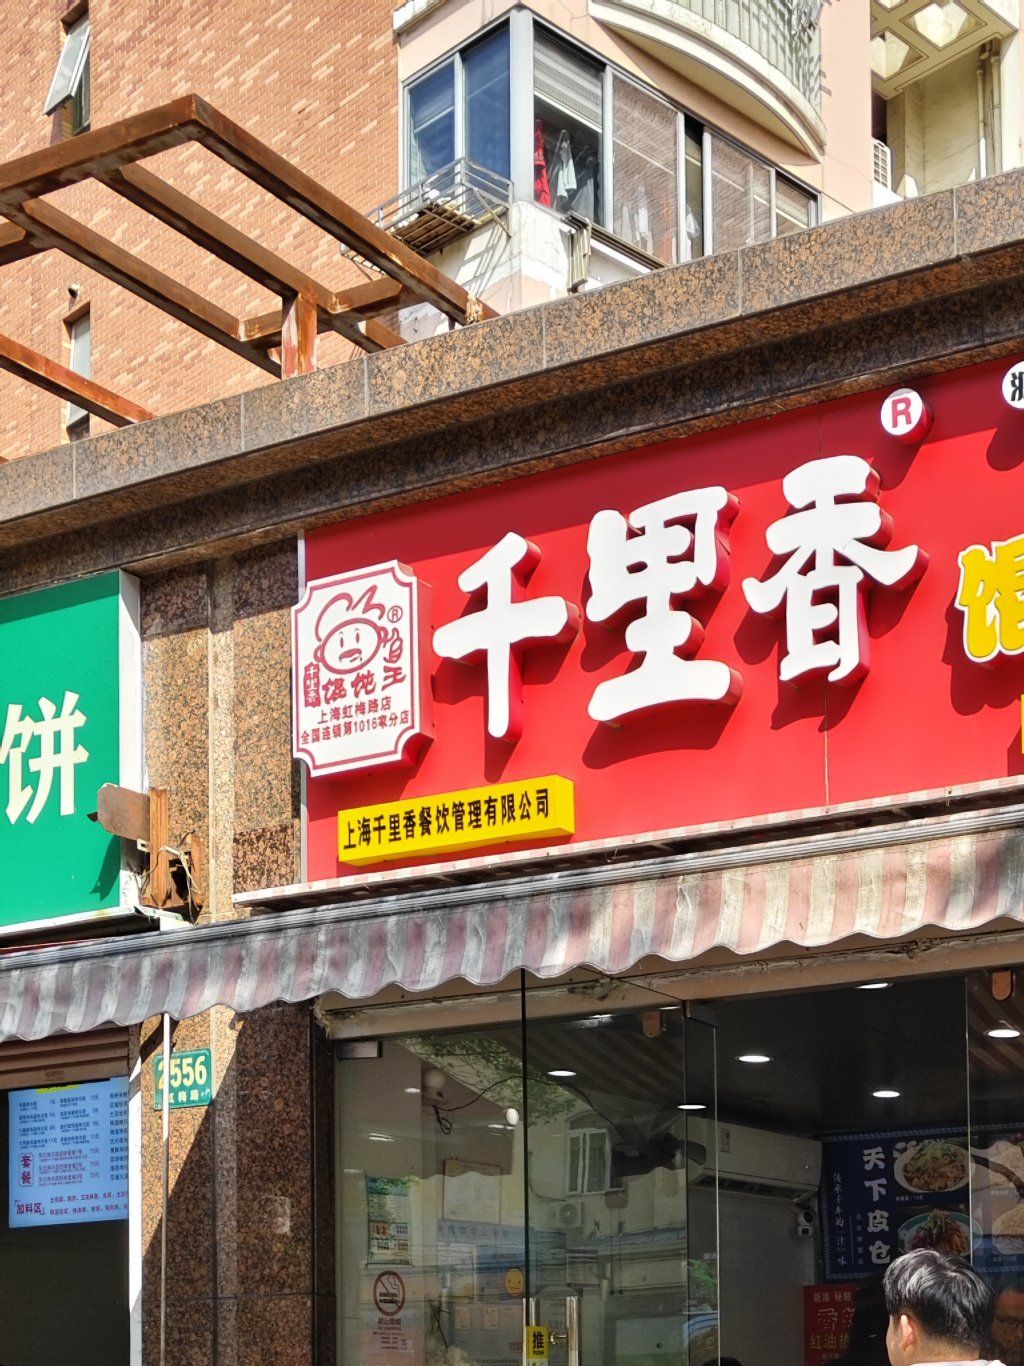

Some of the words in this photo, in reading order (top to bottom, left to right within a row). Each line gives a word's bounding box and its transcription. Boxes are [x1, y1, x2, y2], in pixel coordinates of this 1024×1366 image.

[432, 454, 921, 739] 千里香
[317, 696, 392, 725] 上海虹梅路店
[0, 690, 89, 825] 饼
[343, 788, 551, 850] 上海千里香餐饮管理有限公司
[532, 1331, 544, 1349] 推
